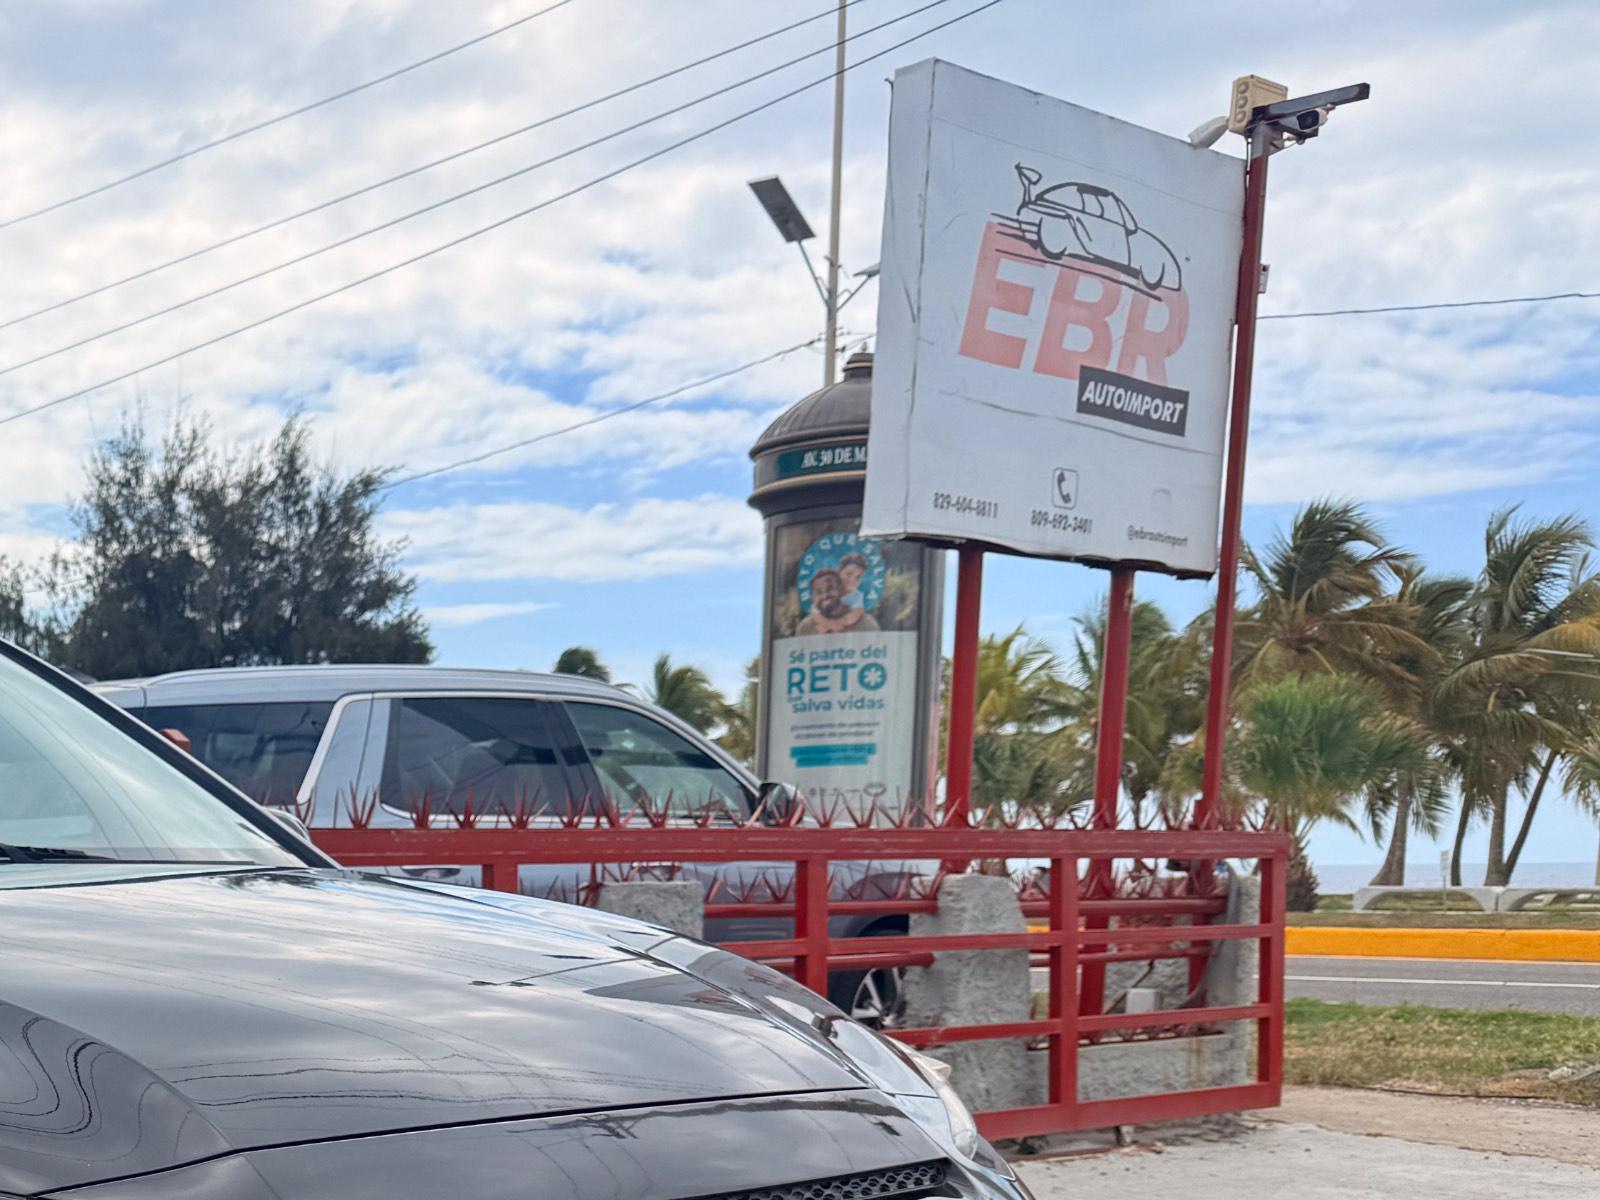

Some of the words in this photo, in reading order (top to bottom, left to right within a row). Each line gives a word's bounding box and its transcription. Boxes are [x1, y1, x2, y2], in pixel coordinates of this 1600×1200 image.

[958, 221, 1190, 386] EBR
[1081, 381, 1184, 425] AUTOIMPORT
[834, 447, 853, 464] DE
[809, 648, 856, 664] parte
[860, 645, 887, 660] del
[787, 662, 888, 696] RETO
[792, 698, 832, 713] salva
[838, 695, 885, 710] vidas
